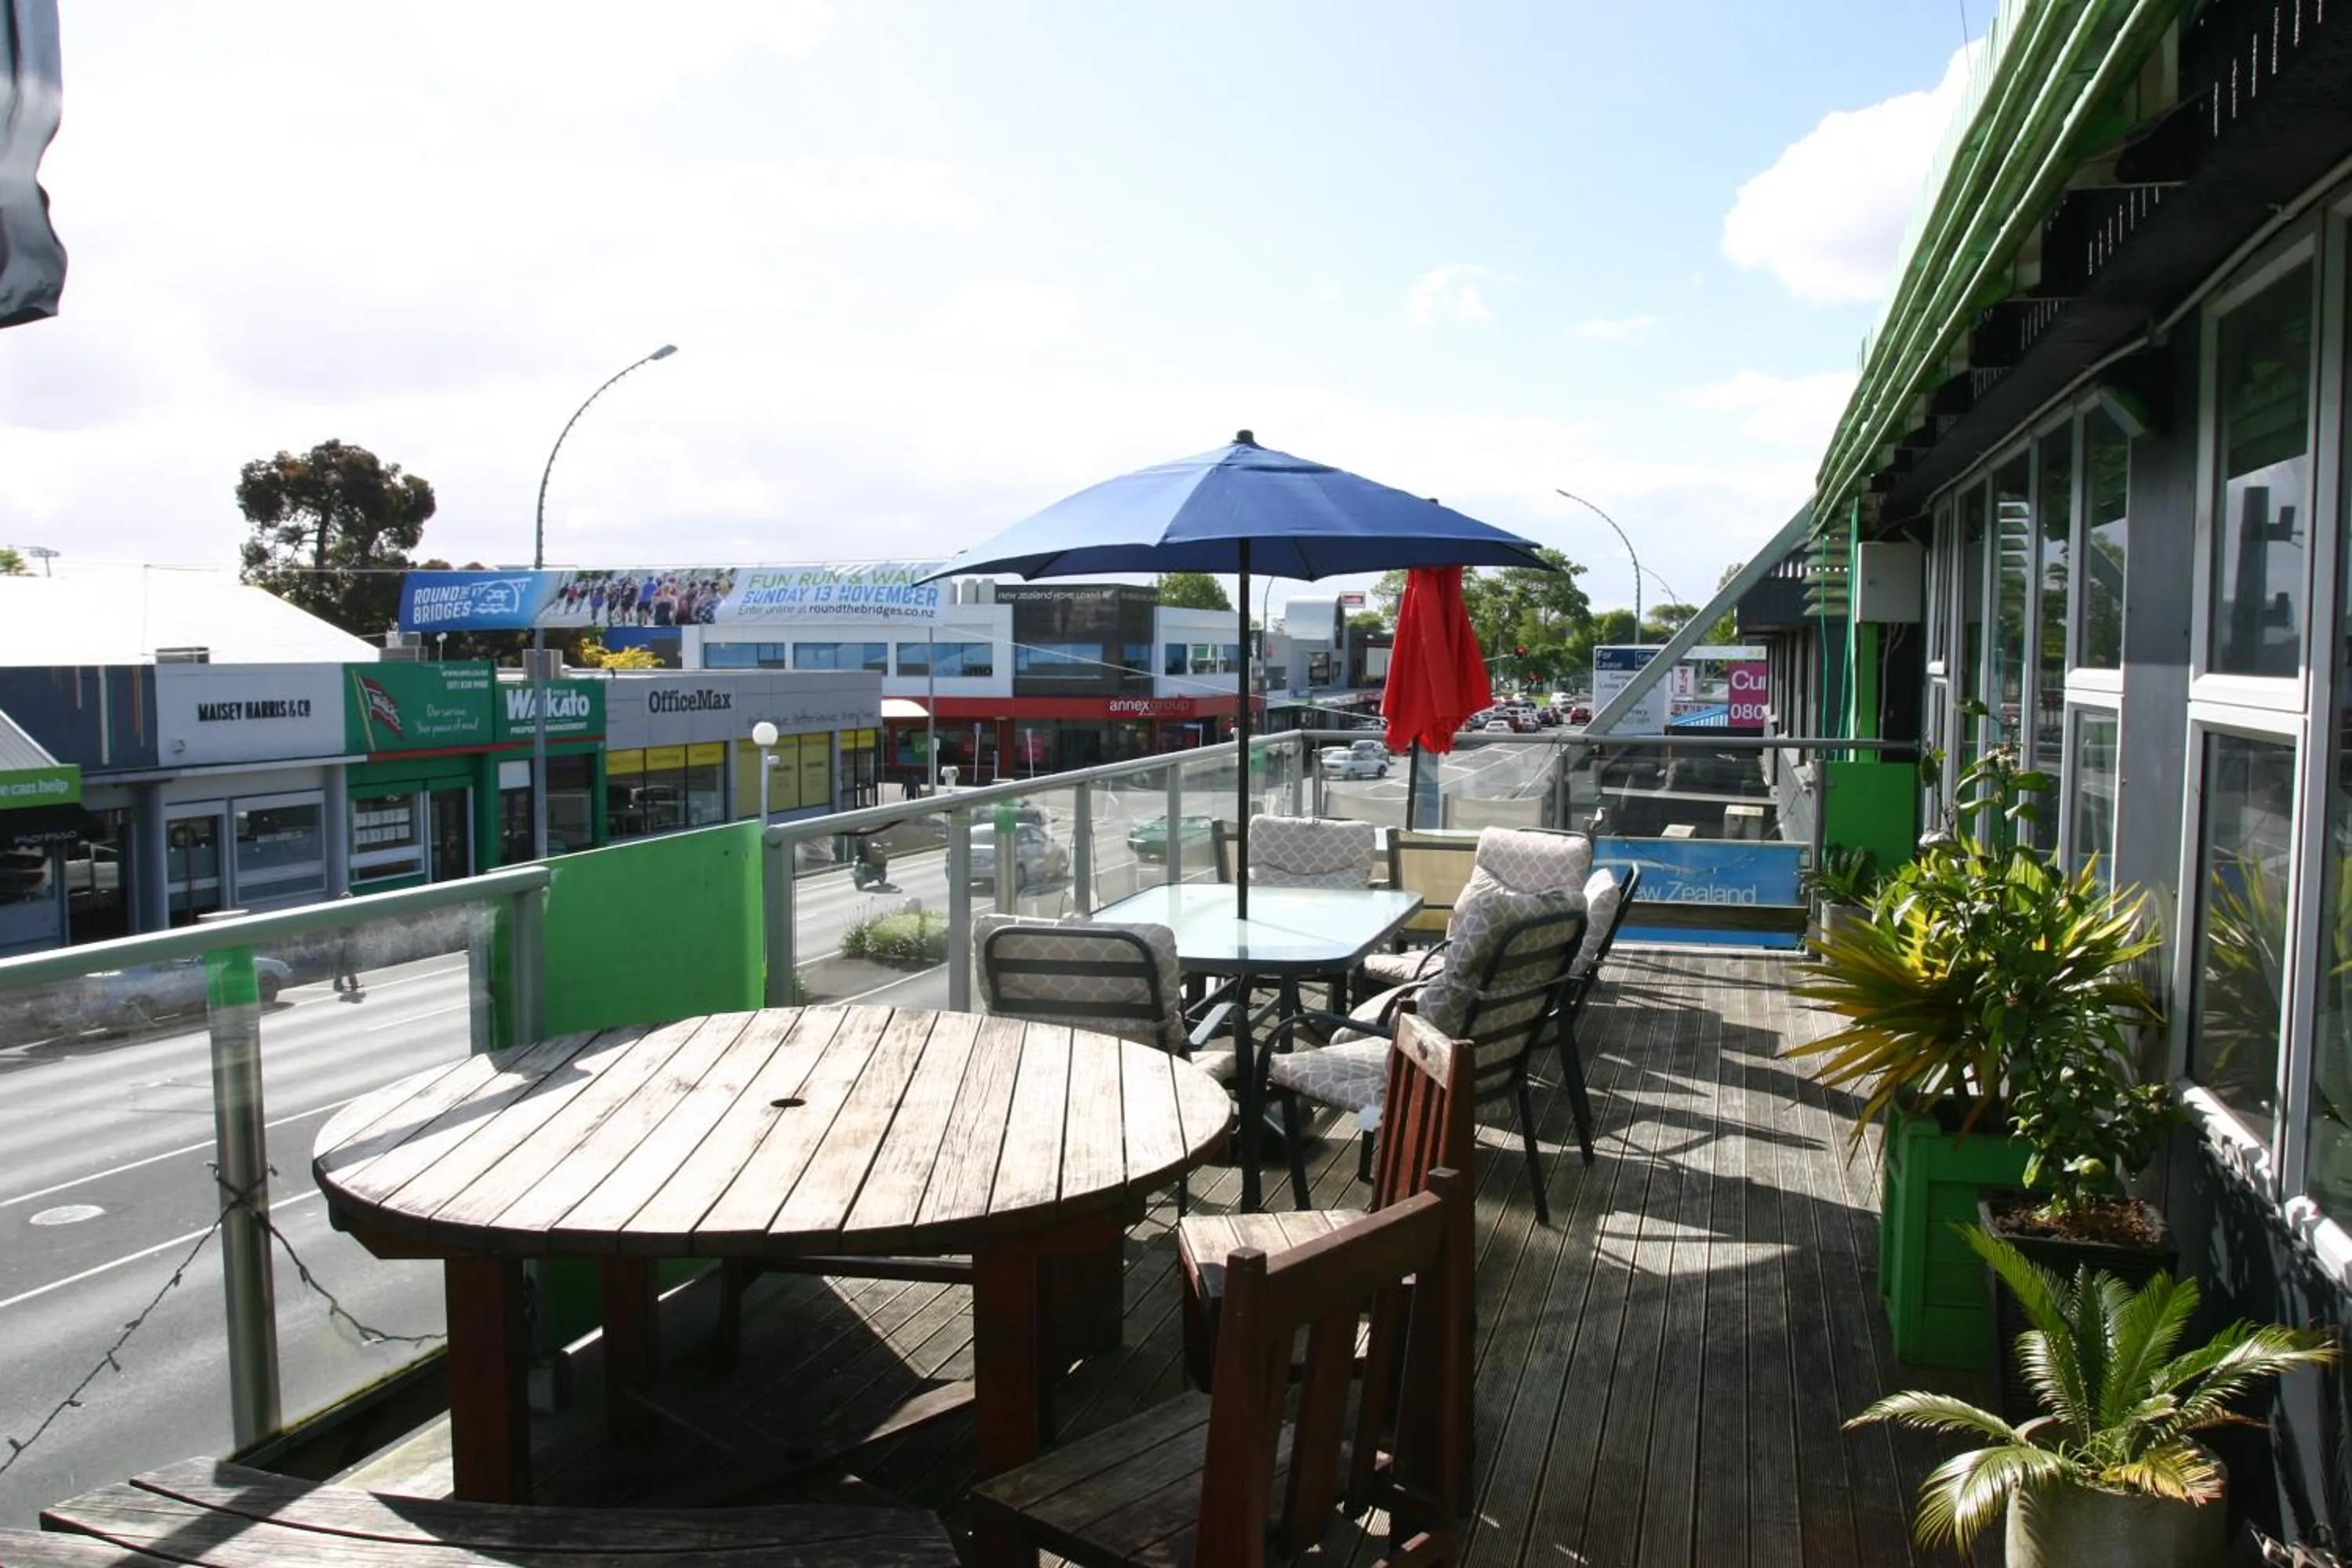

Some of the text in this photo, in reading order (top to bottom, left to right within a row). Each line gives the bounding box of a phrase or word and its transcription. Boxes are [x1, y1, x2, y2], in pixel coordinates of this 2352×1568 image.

[749, 574, 793, 588] FUN
[799, 570, 842, 586] RUN
[414, 586, 460, 605] ROUND
[742, 585, 938, 607] SUNDAY 13 NOVEMBER
[413, 601, 472, 625] BRIDGES
[808, 604, 935, 619] roundthebridges.co.nz
[198, 699, 311, 722] MAISEY HARRIS & CO
[648, 690, 732, 714] OfficeMax
[11, 783, 36, 796] can
[38, 779, 69, 795] help
[1632, 880, 1756, 905] ew Zealand
